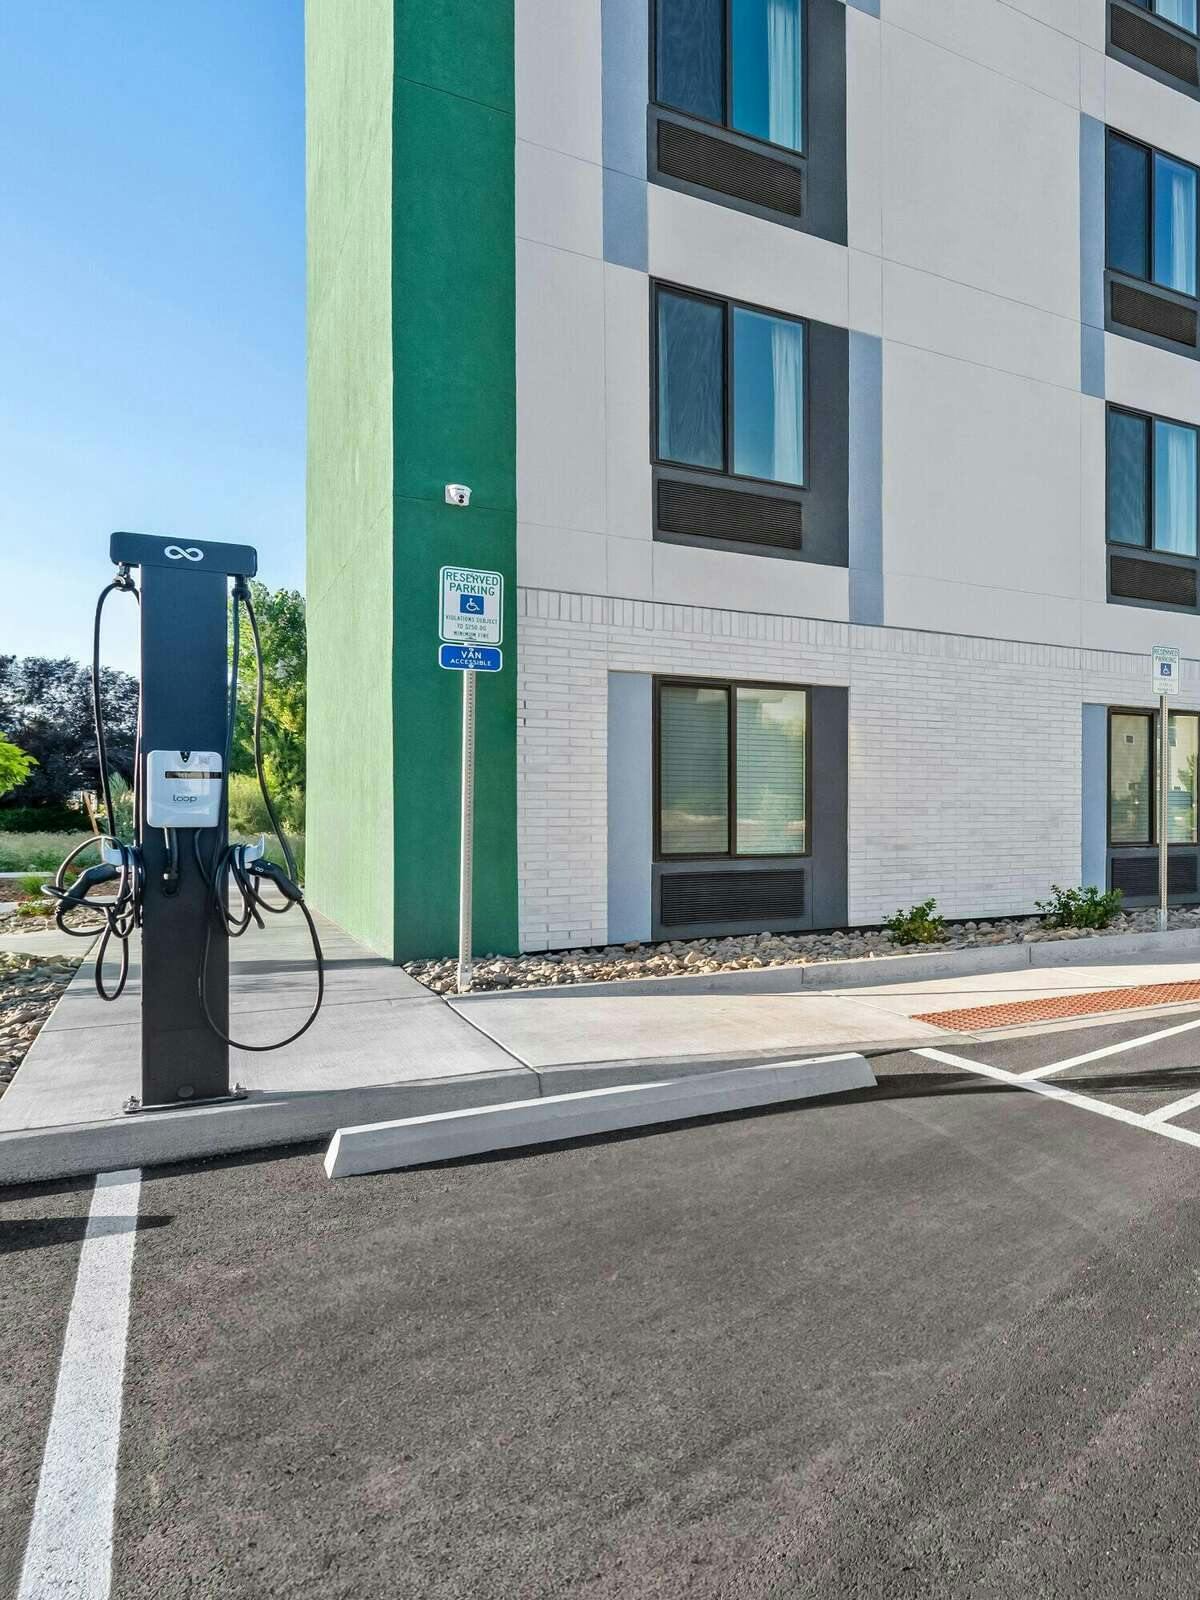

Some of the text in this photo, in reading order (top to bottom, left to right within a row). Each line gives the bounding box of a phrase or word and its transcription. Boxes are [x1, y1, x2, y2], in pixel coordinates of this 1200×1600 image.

[446, 571, 499, 586] RESERVED
[449, 582, 495, 597] PARKING
[461, 650, 482, 659] VAN
[450, 658, 492, 667] ACCESSIBLE
